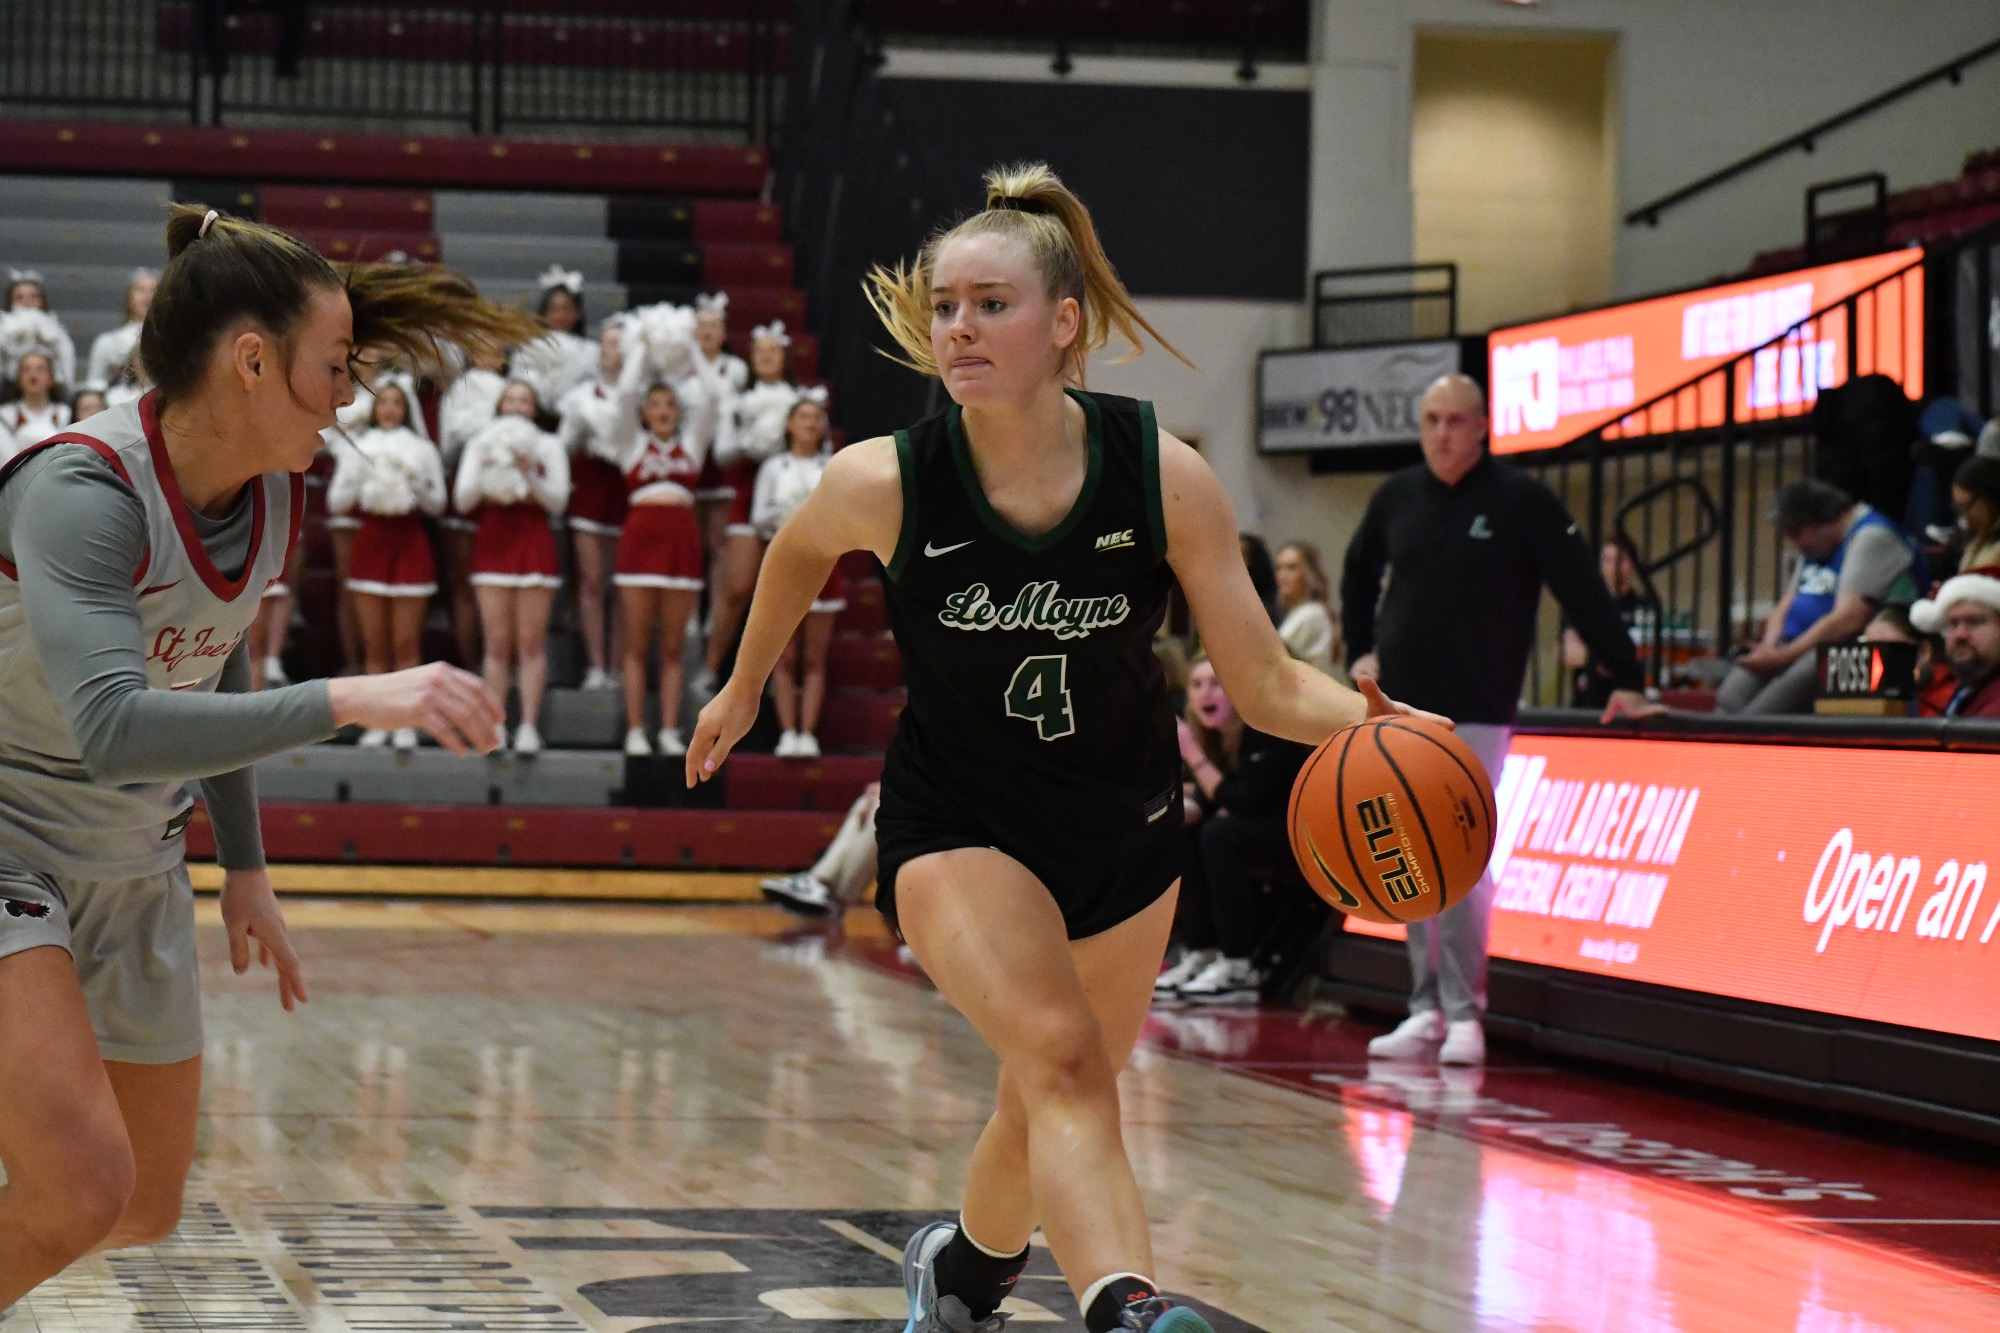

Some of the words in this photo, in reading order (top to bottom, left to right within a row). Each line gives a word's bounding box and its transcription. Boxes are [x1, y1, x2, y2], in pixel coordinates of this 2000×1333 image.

[1094, 528, 1134, 550] NEC
[938, 583, 999, 632] Le
[998, 580, 1131, 641] Moyne
[1004, 654, 1076, 742] 4
[1826, 646, 1871, 692] POSS
[1356, 795, 1421, 904] ELITE
[1515, 778, 1701, 866] PHILADELPHIA
[1803, 827, 1921, 953] Open
[1915, 859, 1988, 940] an
